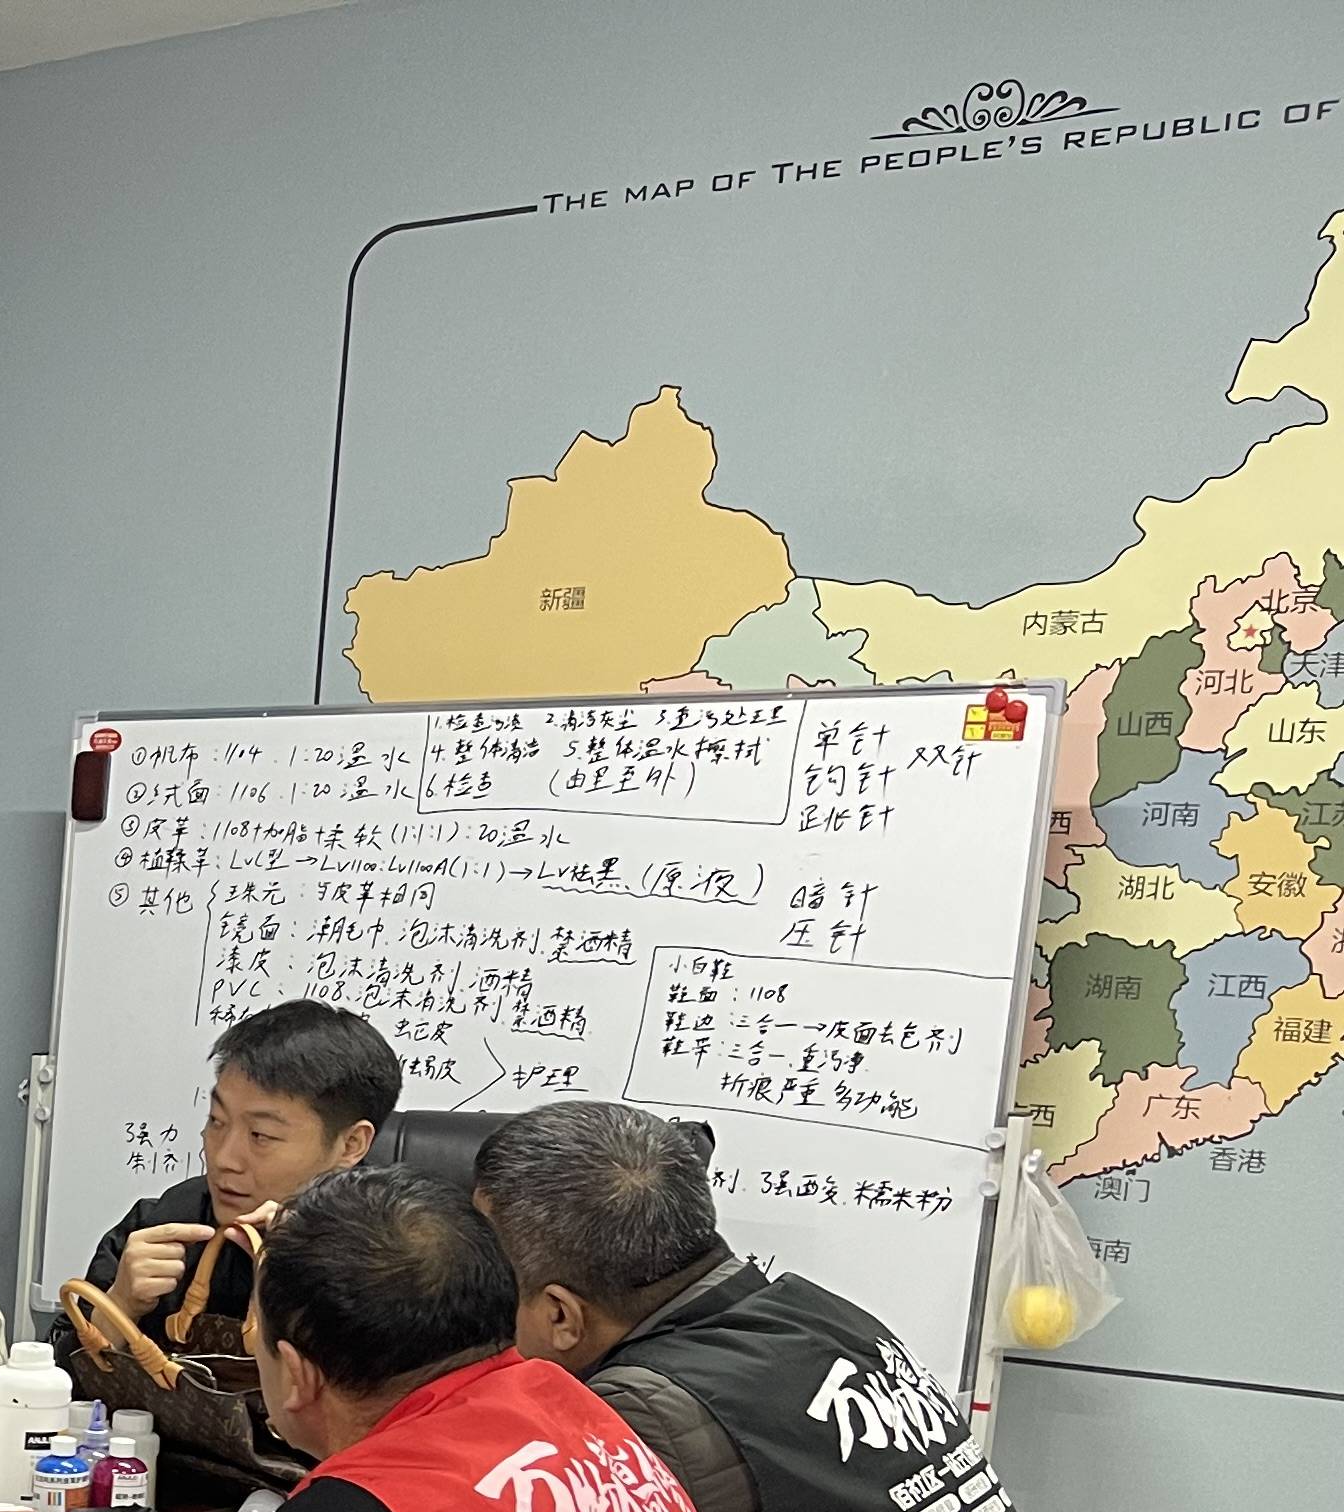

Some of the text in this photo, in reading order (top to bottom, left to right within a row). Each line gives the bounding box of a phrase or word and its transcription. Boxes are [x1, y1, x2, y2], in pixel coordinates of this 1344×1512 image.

[543, 99, 1340, 215] THE MAP OF THE PEOPLE'S REPUBLIC OF
[539, 586, 587, 613] 新疆
[1260, 588, 1320, 615] 北京
[1022, 610, 1107, 636] 内蒙古
[1195, 668, 1254, 696] 河北
[1117, 711, 1173, 737] 山西
[1268, 718, 1326, 745] 山东
[815, 720, 890, 761] 单针
[1142, 803, 1199, 827] 河南
[1118, 875, 1174, 902] 湖北
[1248, 872, 1308, 899] 安徽
[669, 956, 734, 981] 小白鞋
[1085, 975, 1143, 1000] 湖南
[1208, 973, 1267, 999] 江西
[1274, 1017, 1332, 1043] 福建
[513, 1063, 579, 1090] 护理
[1143, 1095, 1201, 1121] 广东
[125, 1122, 178, 1148] 强力
[1209, 1148, 1267, 1174] 香港
[1094, 1177, 1151, 1203] 澳门
